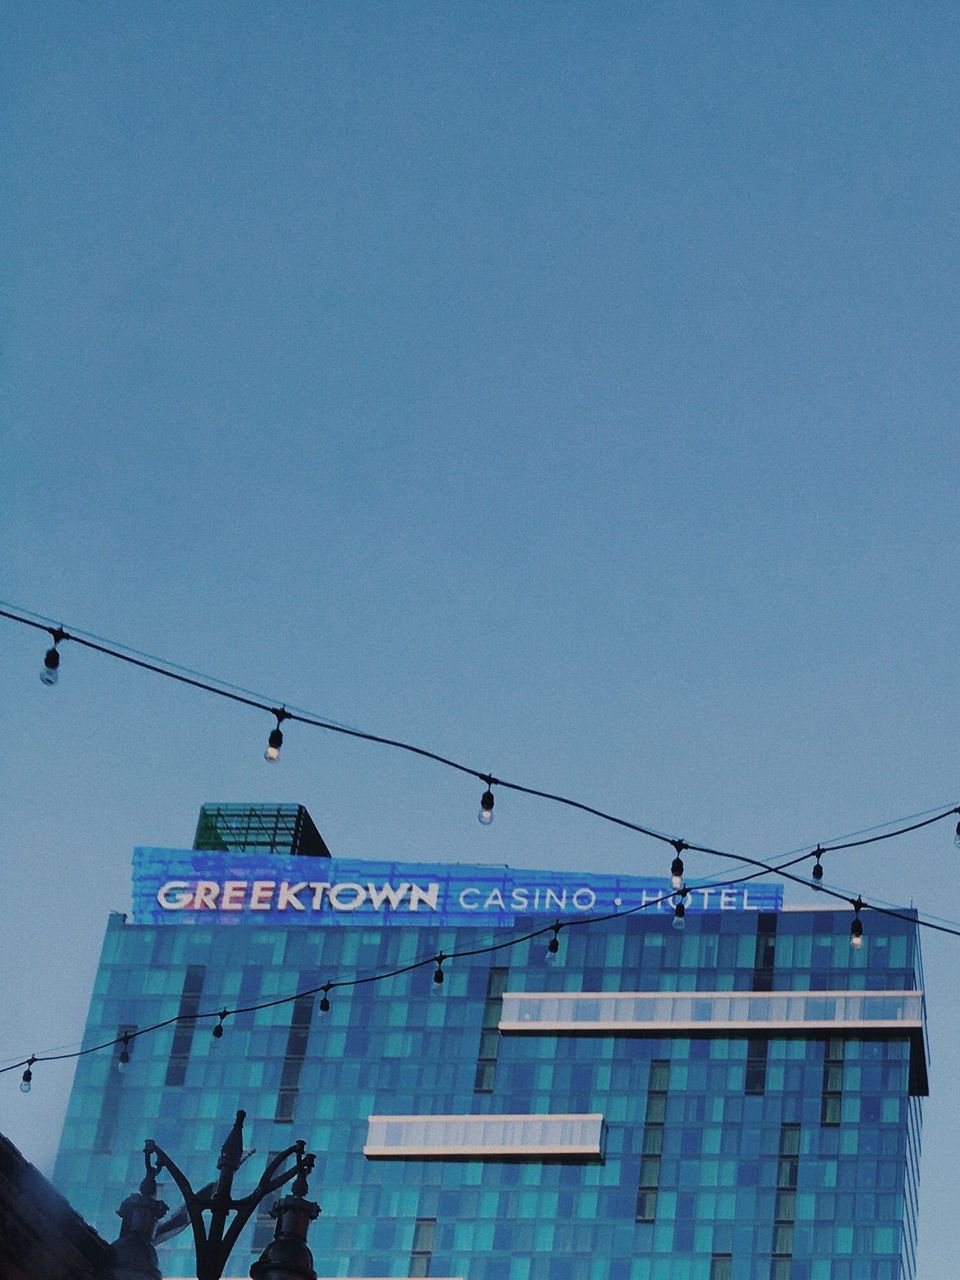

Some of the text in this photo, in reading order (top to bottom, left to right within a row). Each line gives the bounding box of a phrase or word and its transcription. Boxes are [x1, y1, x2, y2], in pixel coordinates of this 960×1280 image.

[157, 880, 759, 912] GREEKTOWN CASINO HOTEL
